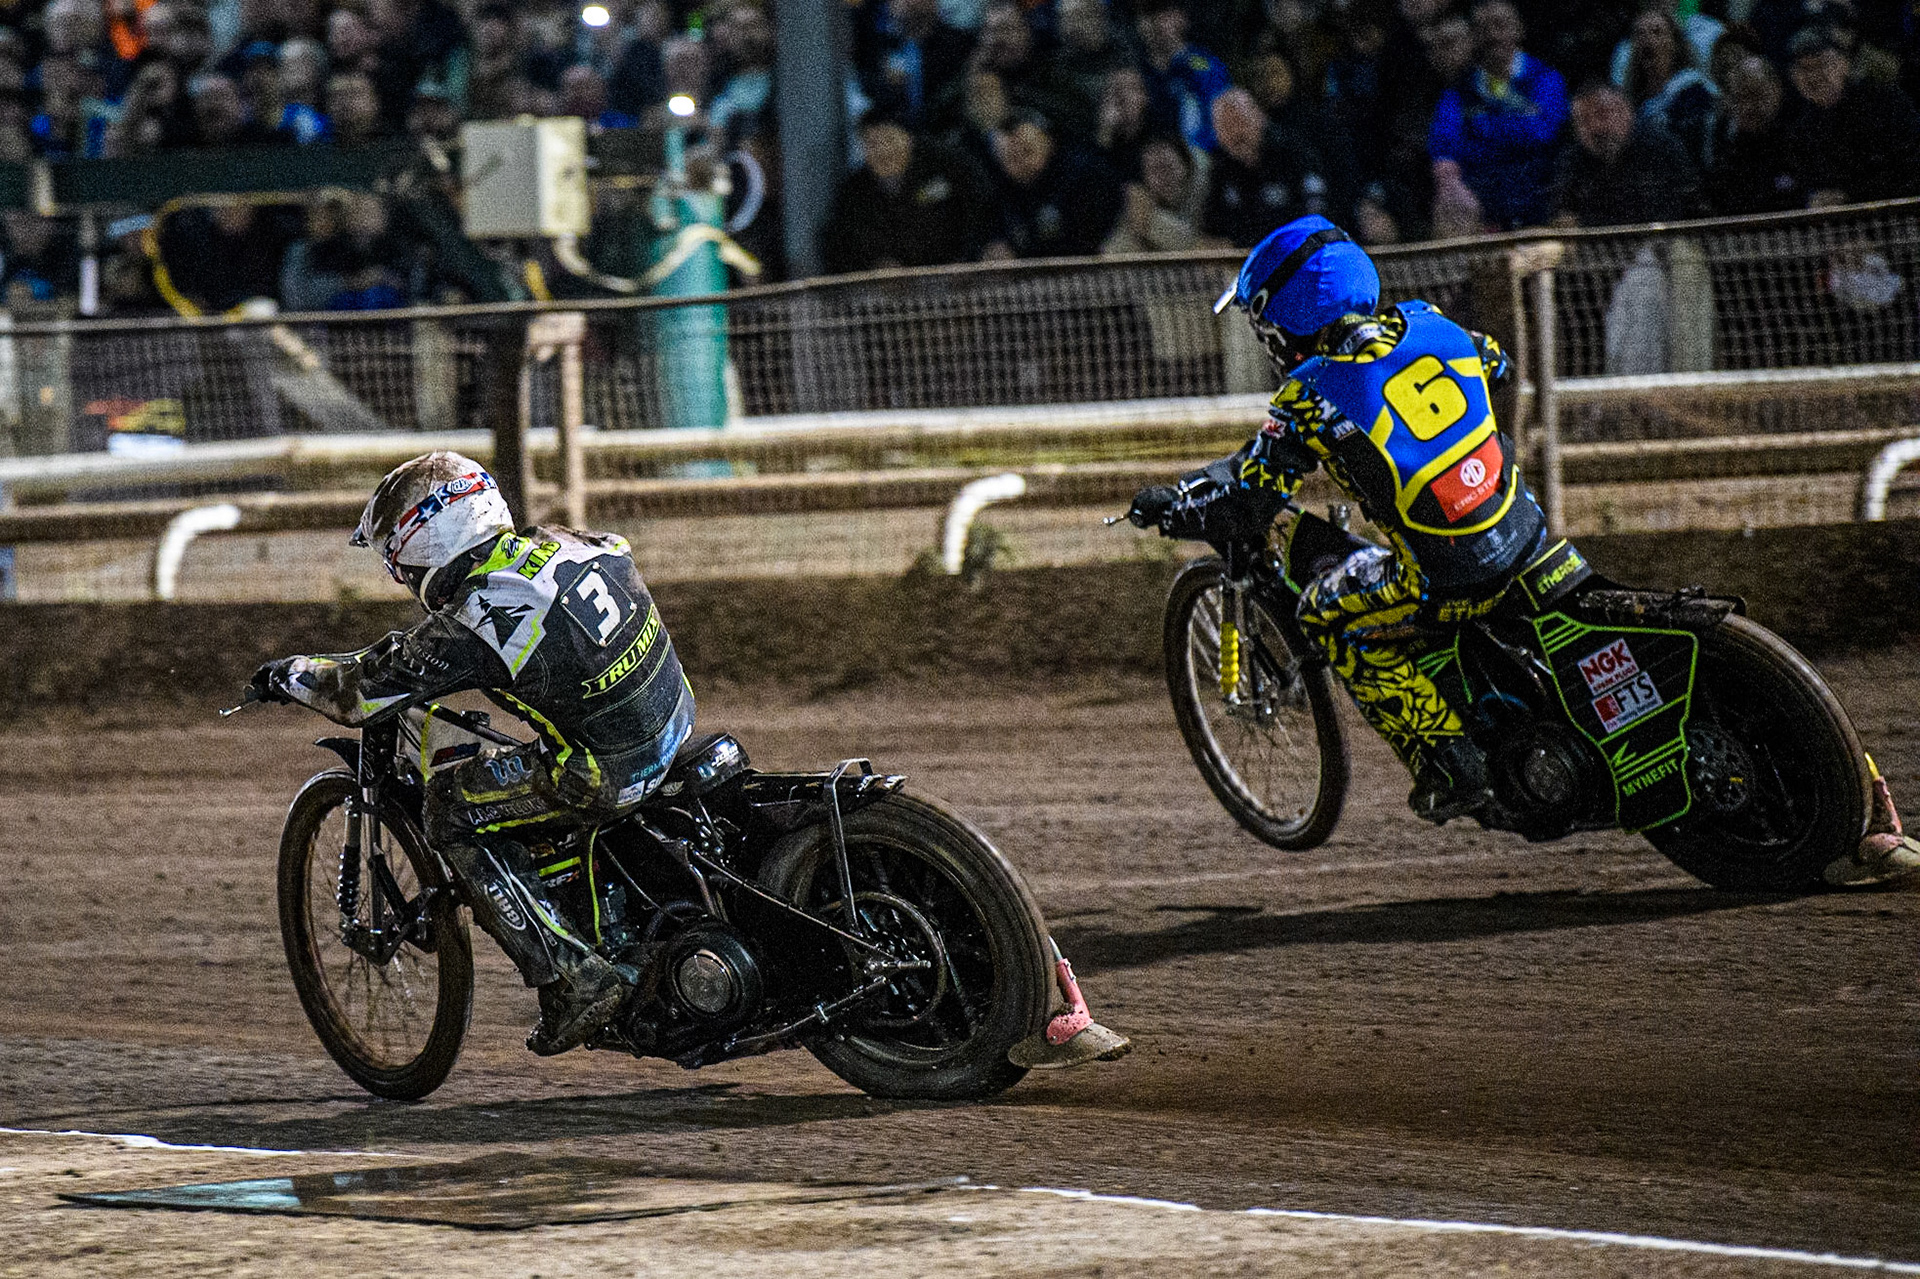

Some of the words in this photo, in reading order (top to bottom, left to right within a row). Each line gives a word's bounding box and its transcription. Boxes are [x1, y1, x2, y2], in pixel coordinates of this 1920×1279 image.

[1383, 354, 1468, 441] 6
[517, 541, 561, 580] KING
[575, 570, 621, 641] 3
[1581, 641, 1631, 685] NGK
[1612, 674, 1653, 712] FTS
